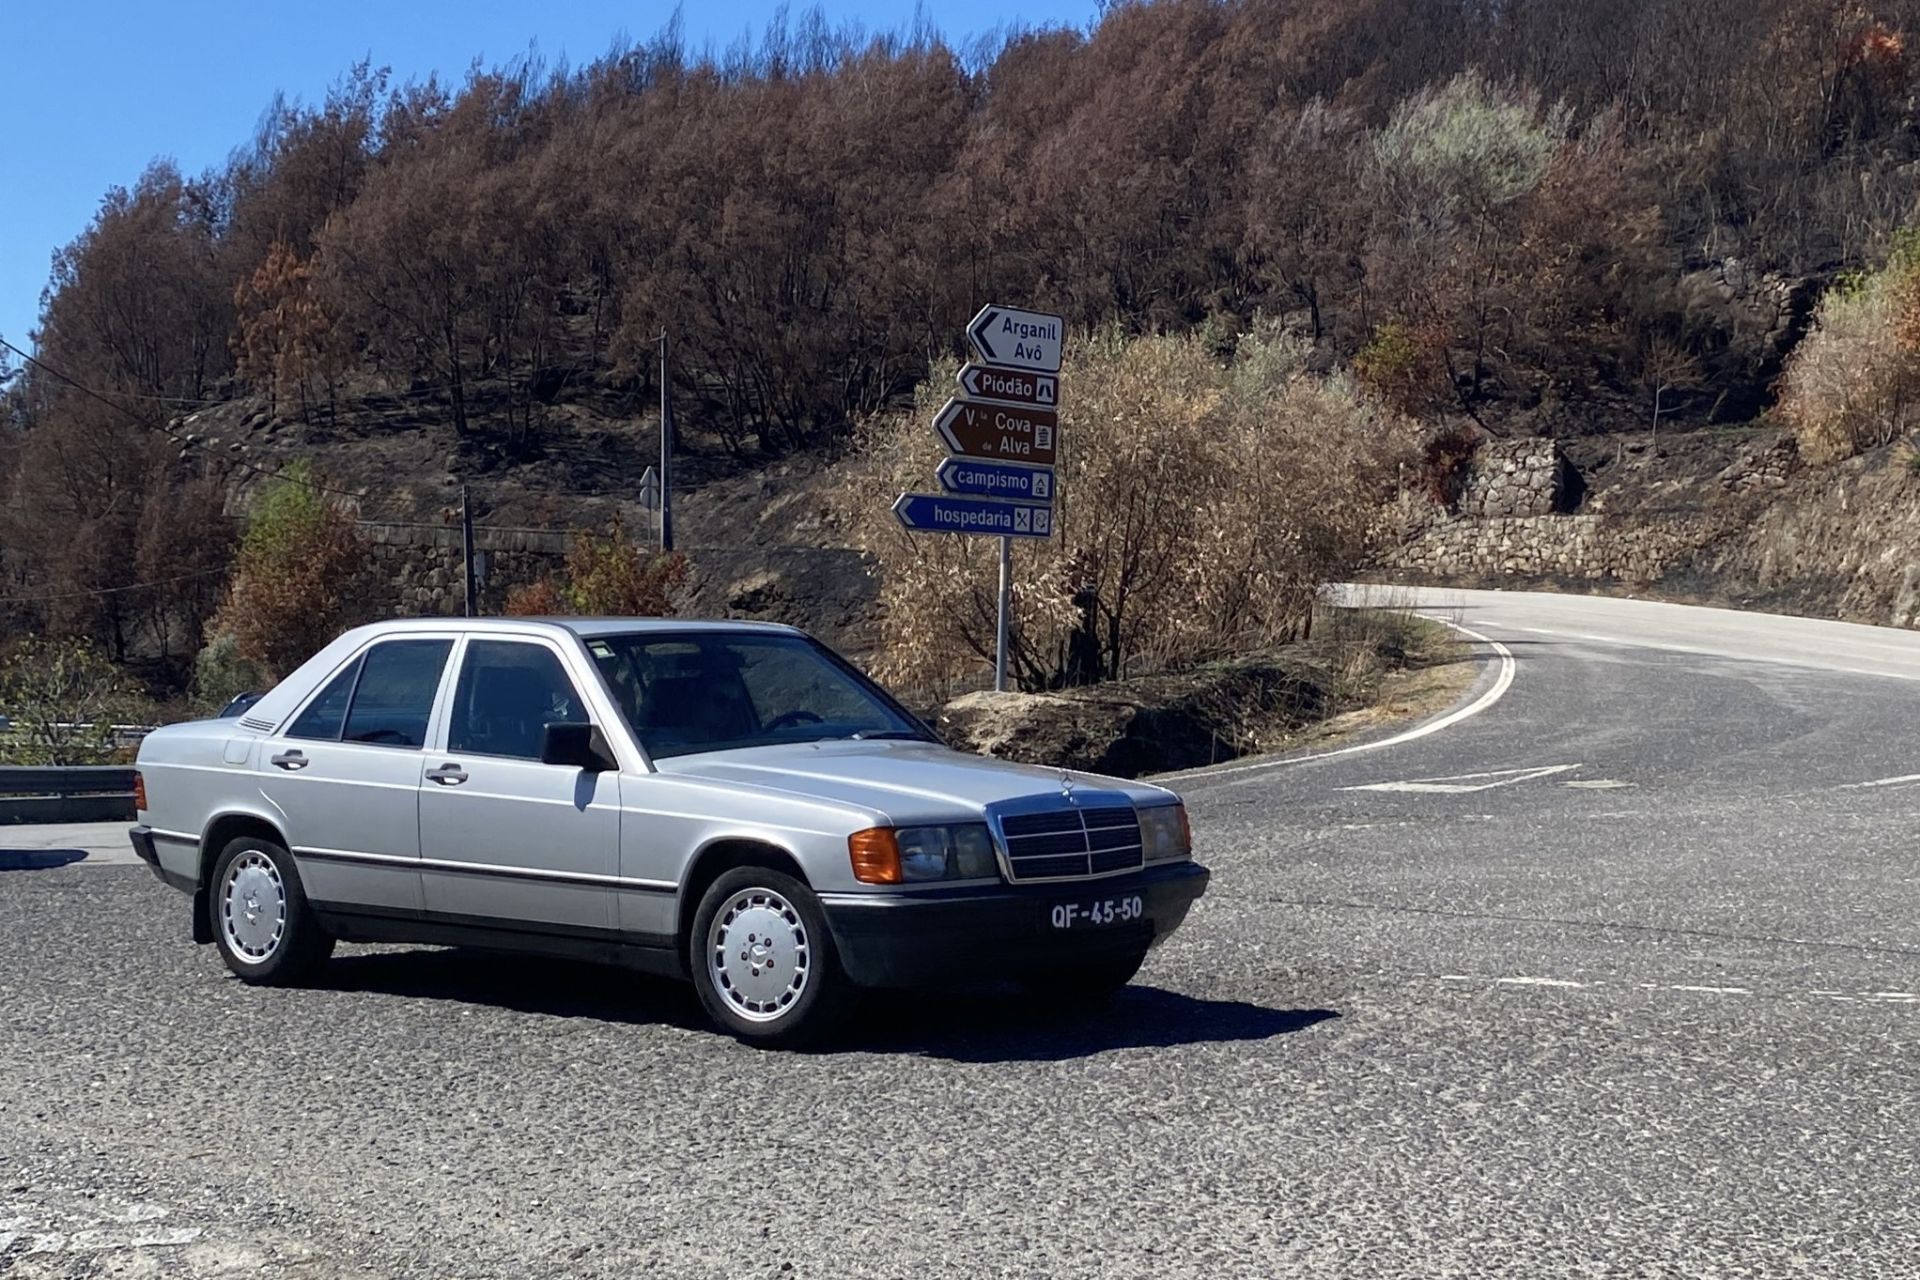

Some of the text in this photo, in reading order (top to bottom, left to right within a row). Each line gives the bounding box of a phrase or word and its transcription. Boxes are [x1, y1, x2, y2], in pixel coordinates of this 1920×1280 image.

[1002, 317, 1056, 340] Arganil
[1014, 342, 1042, 361] Avô
[982, 374, 1033, 396] Piódão
[995, 412, 1031, 433] Cova
[1000, 436, 1030, 455] Alva
[957, 470, 1029, 490] campismo
[934, 504, 1011, 528] hospedaria
